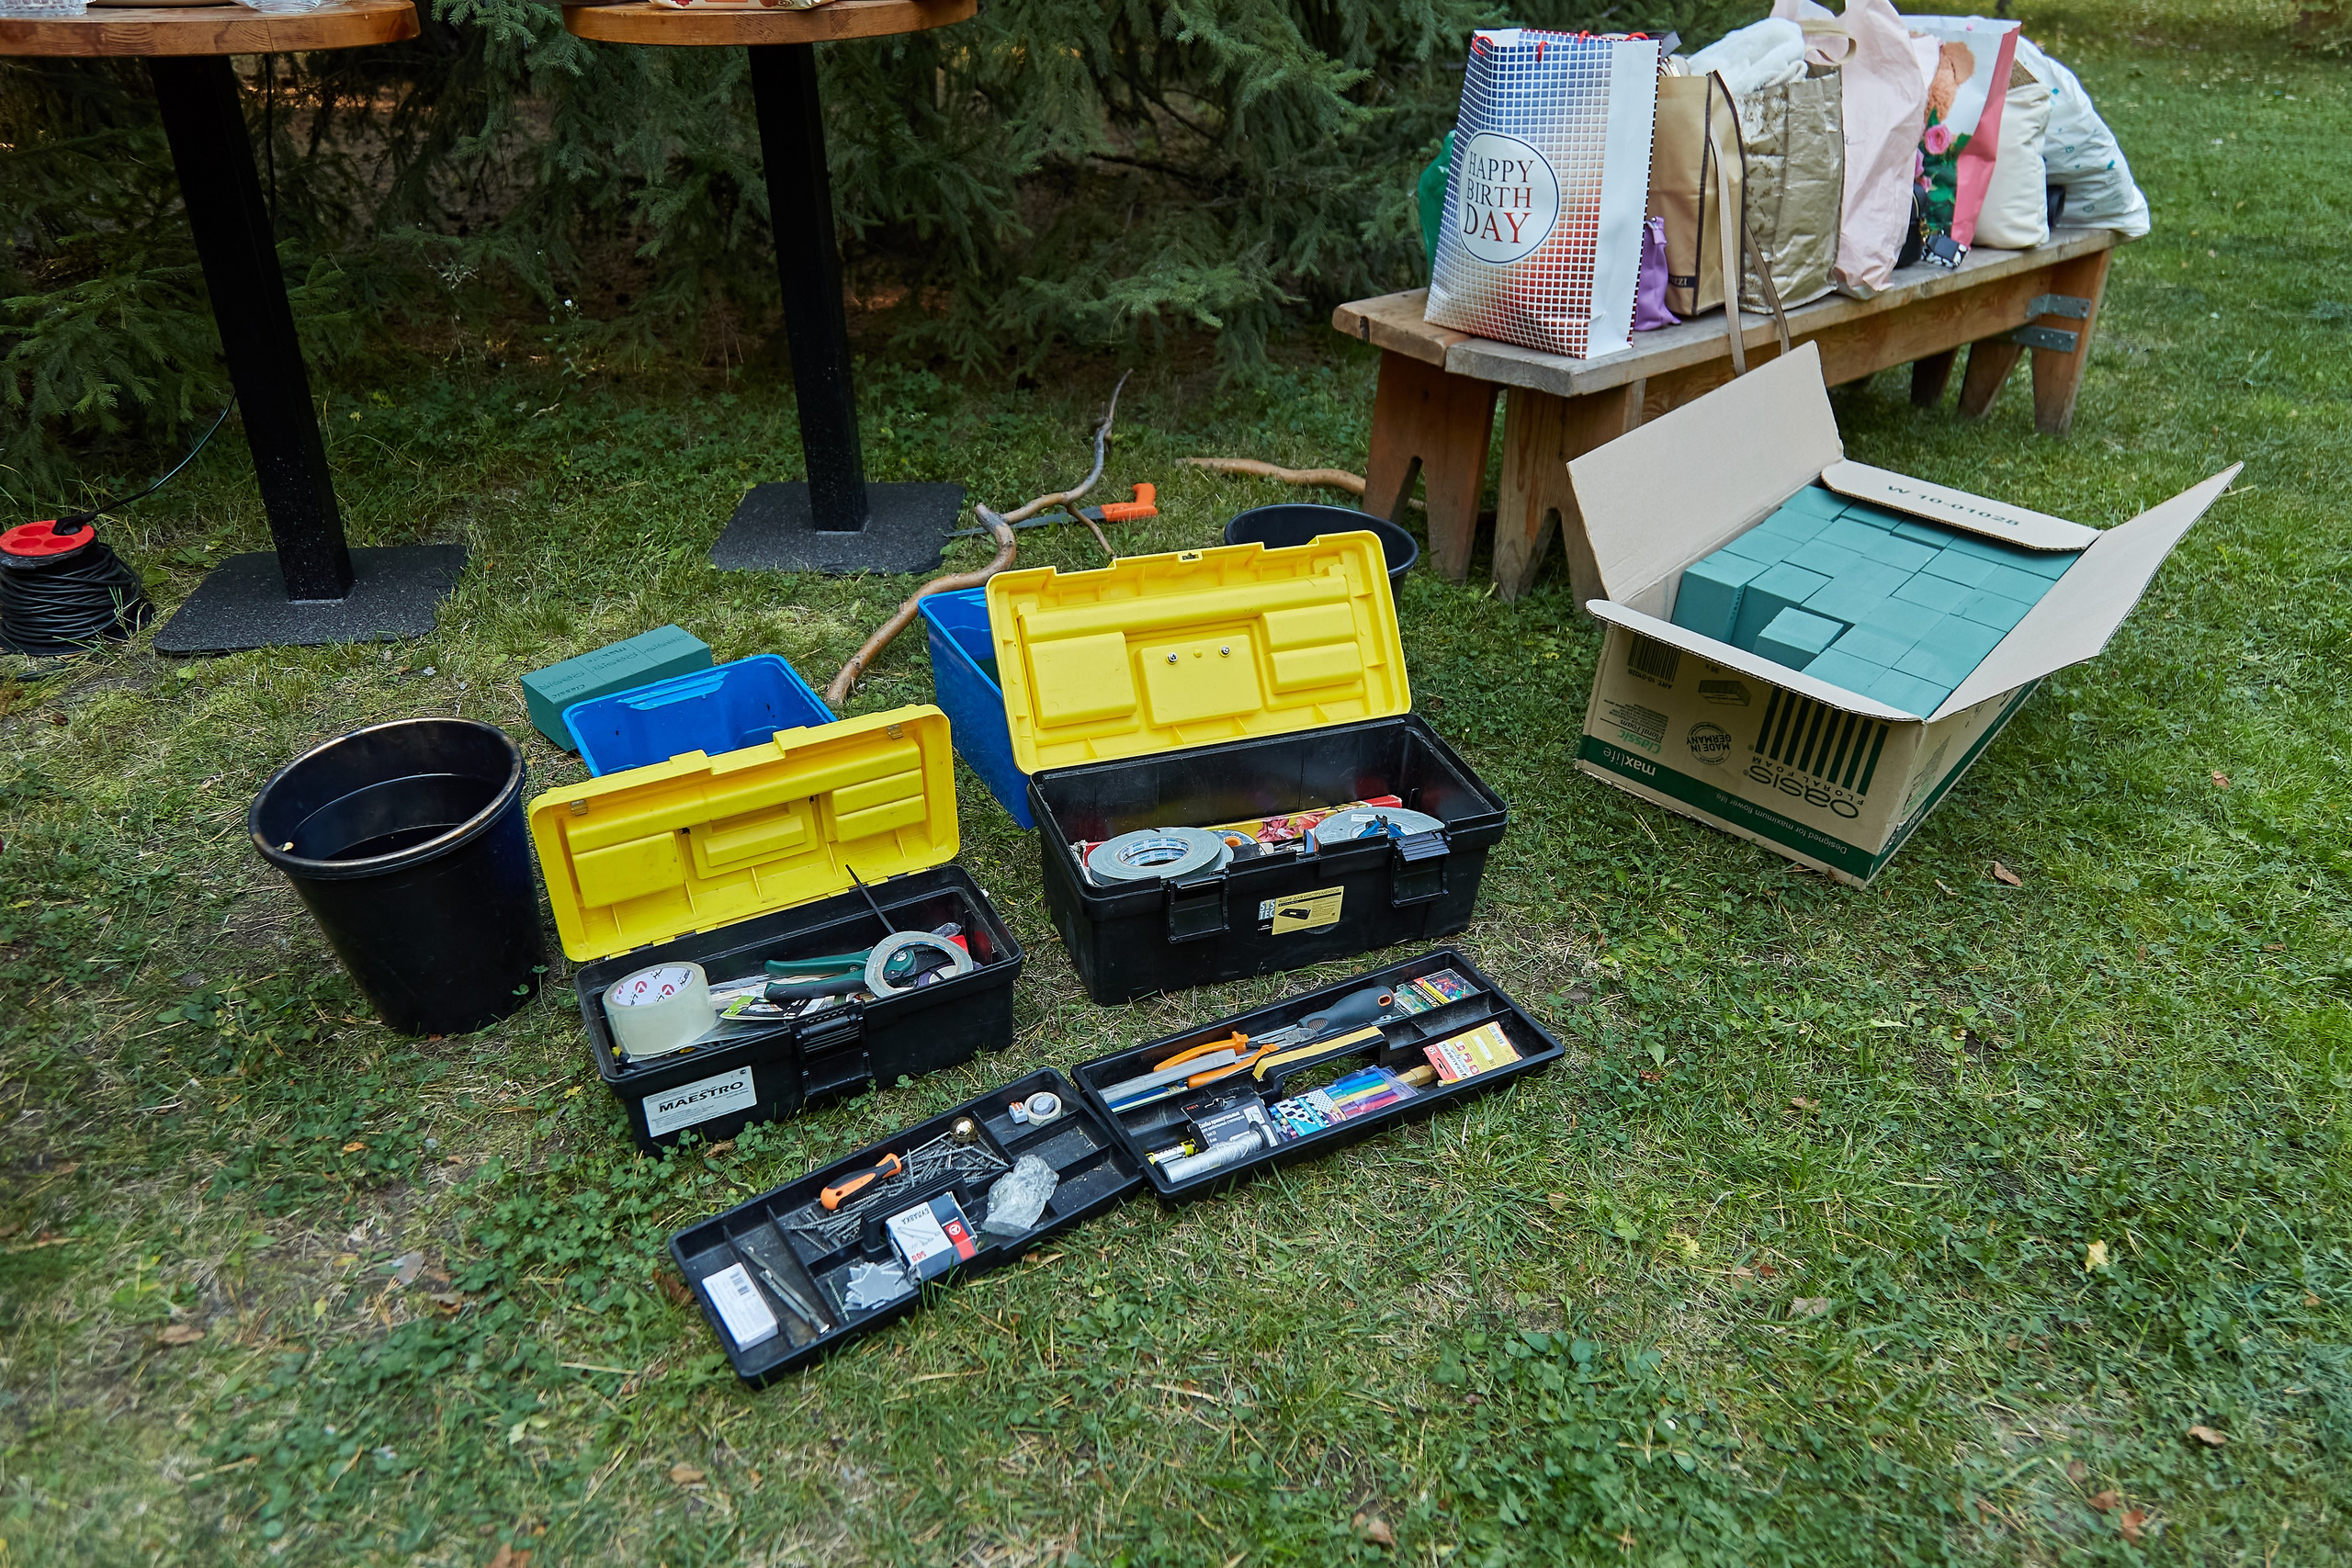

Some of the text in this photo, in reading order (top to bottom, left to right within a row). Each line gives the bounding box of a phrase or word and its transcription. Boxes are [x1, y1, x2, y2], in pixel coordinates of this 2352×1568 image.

[1468, 151, 1535, 184] HAPPY
[1466, 177, 1533, 209] BIRTH
[1463, 202, 1532, 244] DAY
[1888, 485, 2020, 527] W 10-01028
[1617, 728, 1662, 755] Classic
[1620, 718, 1664, 742] Floral Foam
[1686, 735, 1732, 746] GERMANY
[1690, 742, 1731, 753] MADE IN
[1603, 746, 1657, 777] maxlife
[1751, 756, 1865, 807] FLORAL FOAM
[1728, 797, 1754, 817] flower
[1754, 808, 1795, 831] maximum
[1794, 827, 1806, 838] for
[1807, 831, 1849, 855] Designed
[1259, 908, 1275, 920] TEC
[1260, 899, 1276, 911] SYS
[1428, 1045, 1438, 1055] 10
[1442, 1043, 1464, 1076] BRAUBERG
[659, 1081, 744, 1113] MAESTRO
[900, 1207, 931, 1225] БУЛАВКА
[910, 1250, 927, 1263] 500
